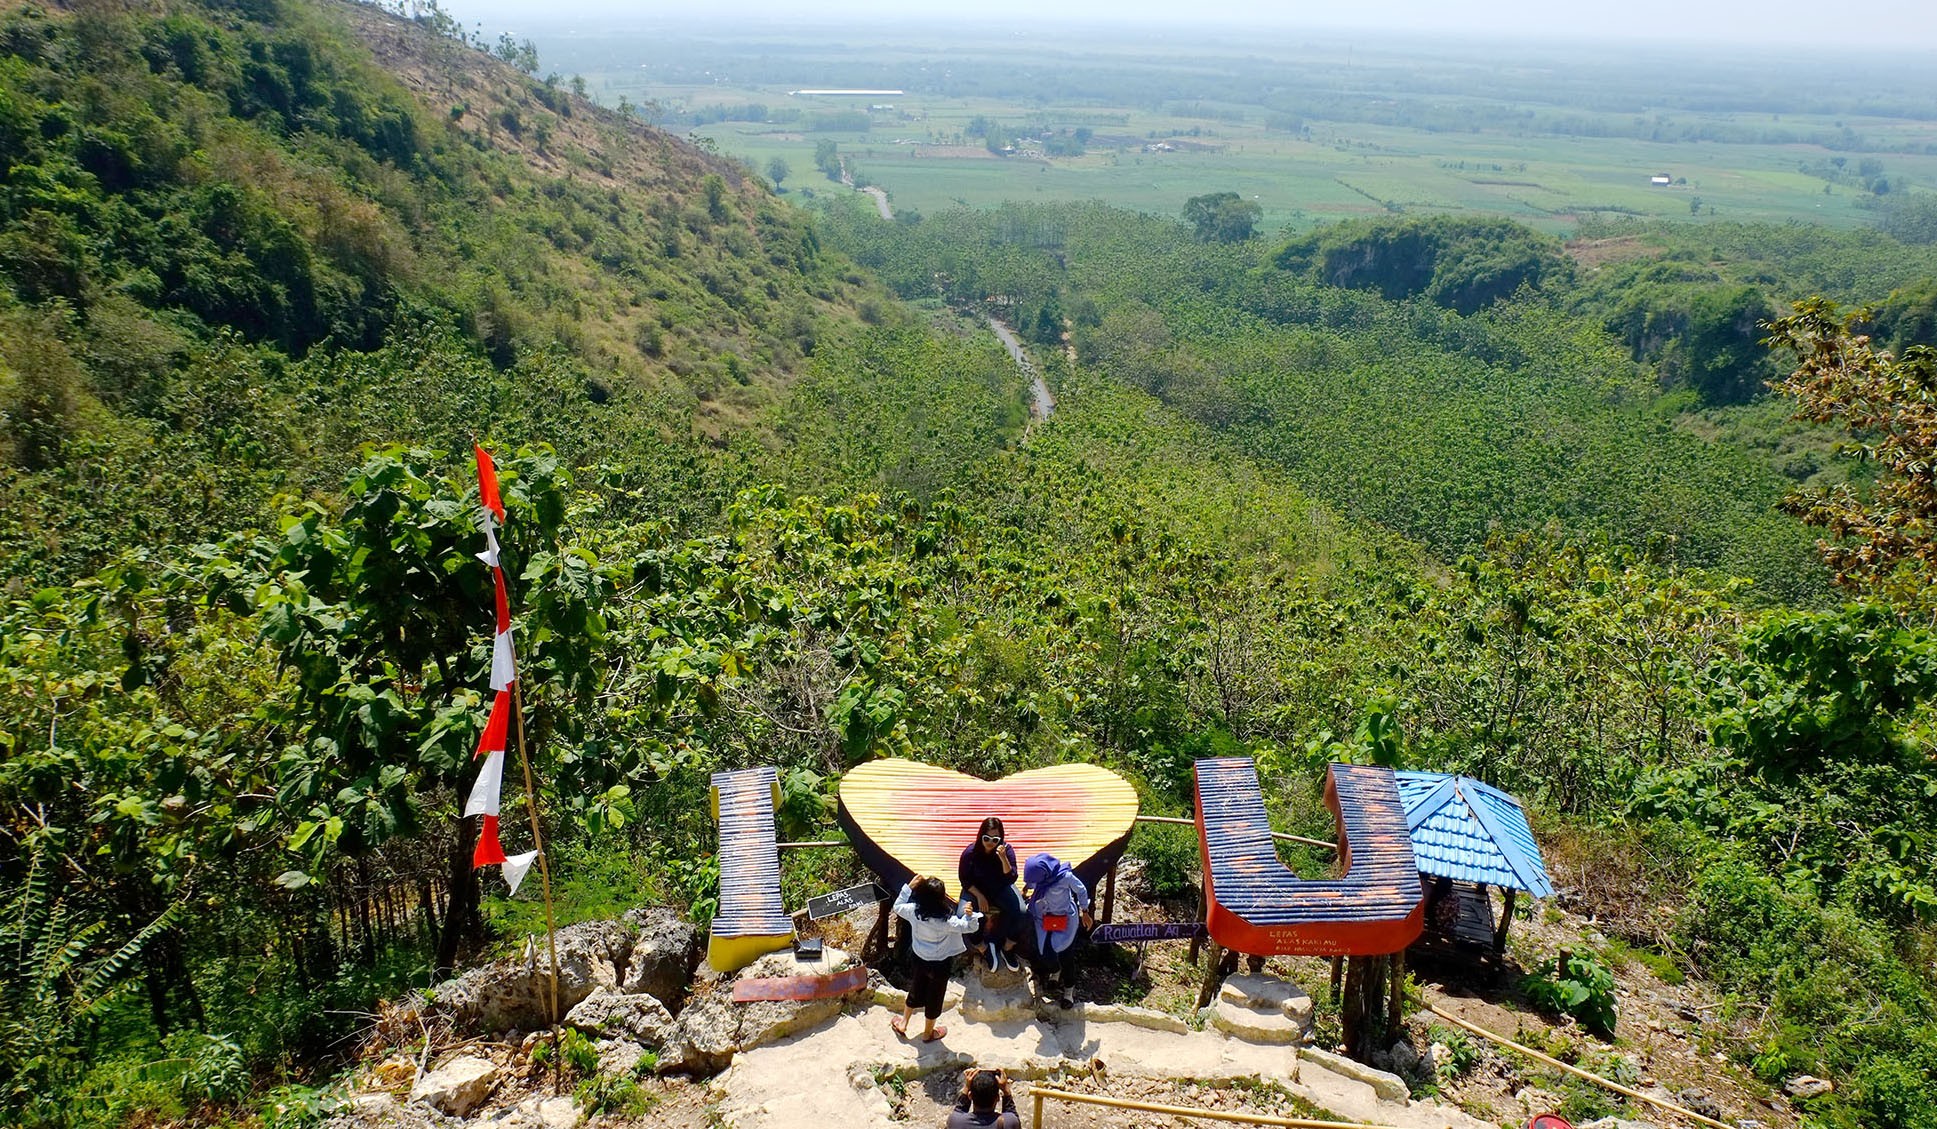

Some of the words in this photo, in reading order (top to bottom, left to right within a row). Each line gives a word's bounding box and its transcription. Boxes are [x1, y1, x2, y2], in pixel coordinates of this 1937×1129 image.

[837, 897, 853, 906] ALAS
[1104, 924, 1158, 941] Rawatlah
[1269, 930, 1298, 938] LEPAS
